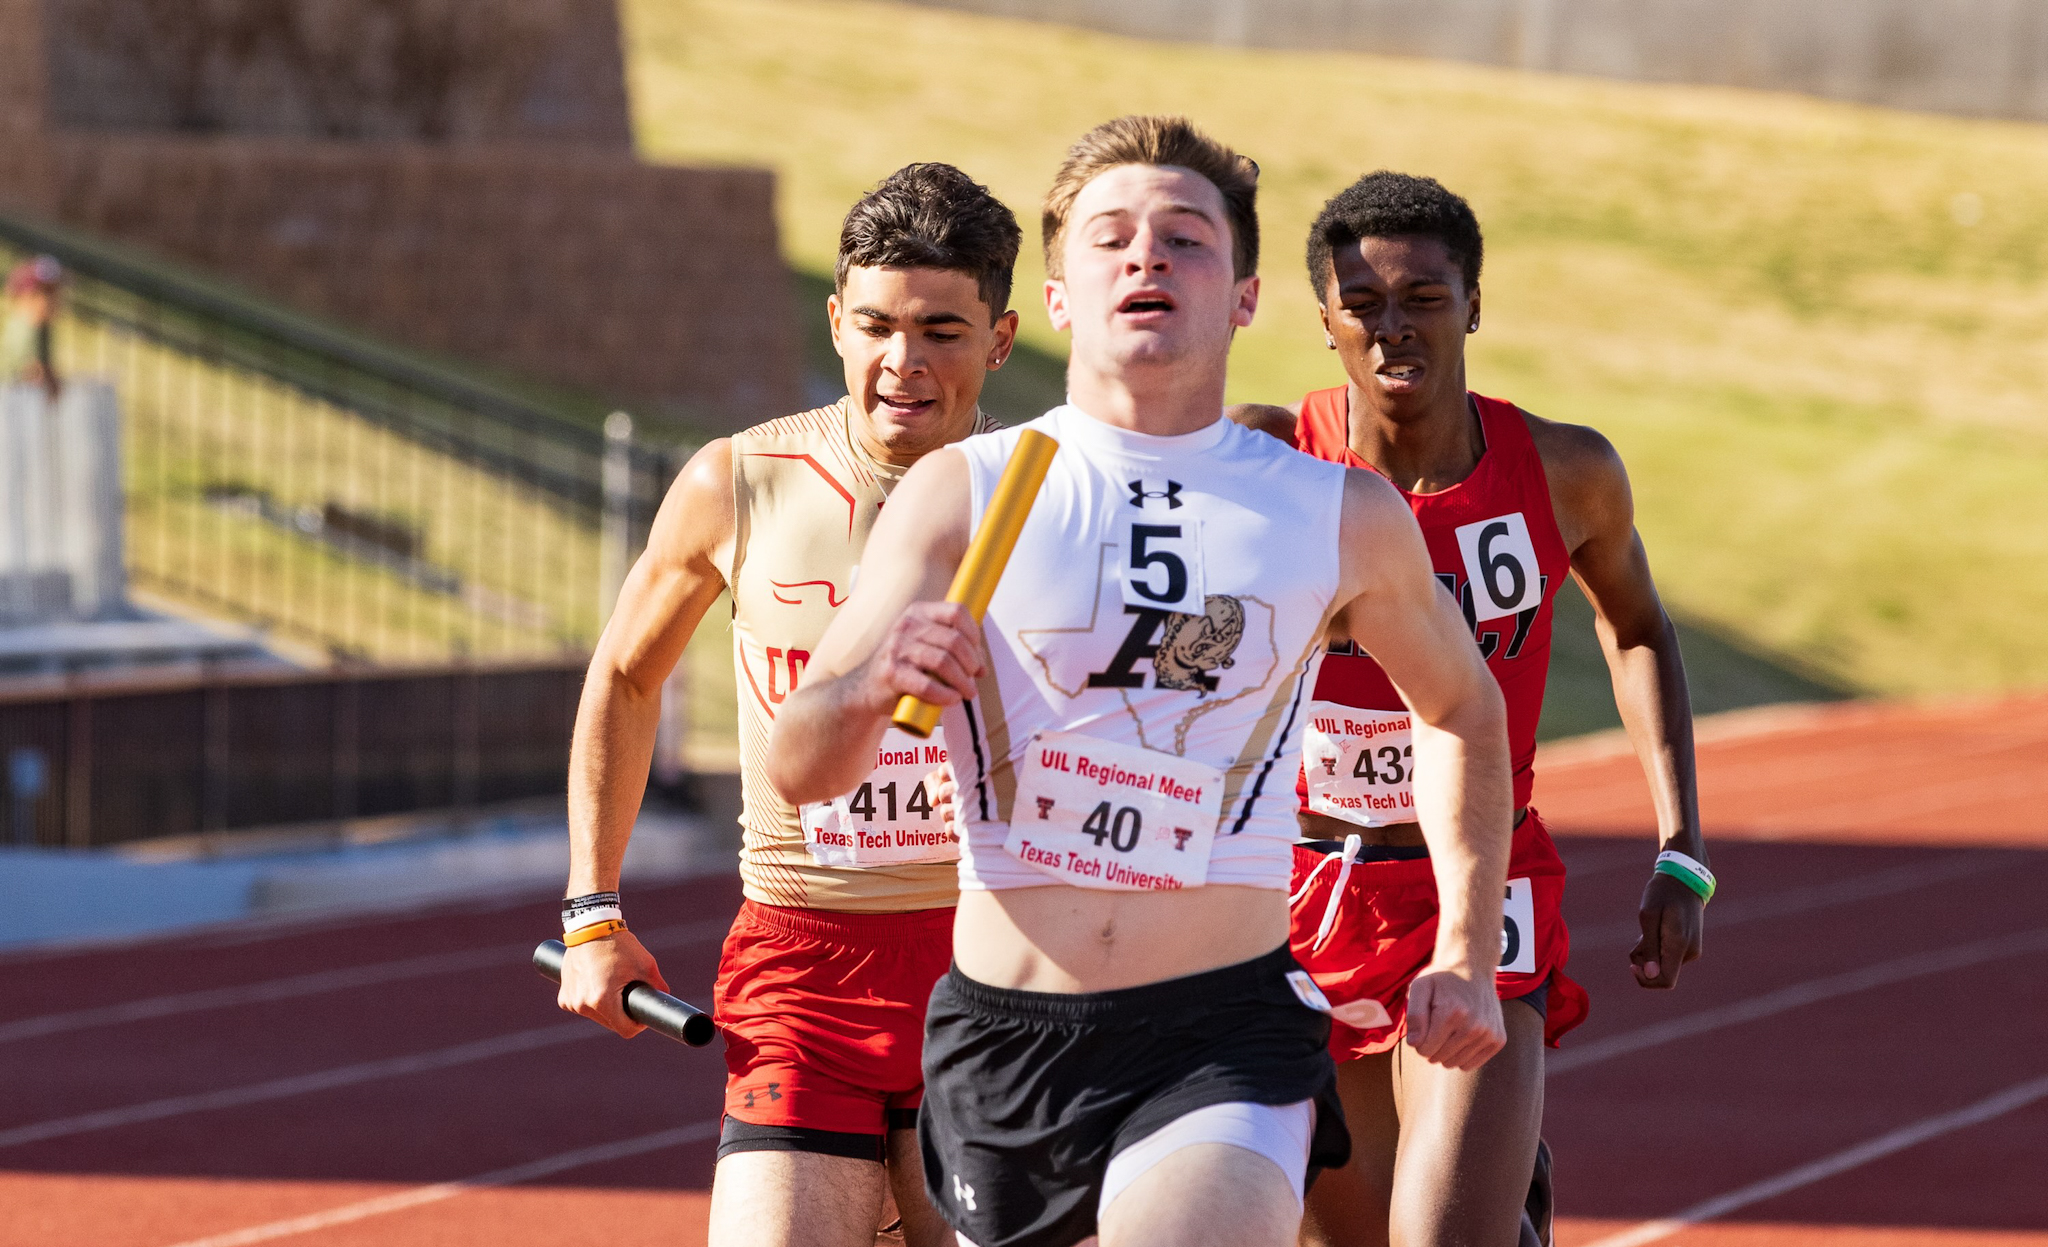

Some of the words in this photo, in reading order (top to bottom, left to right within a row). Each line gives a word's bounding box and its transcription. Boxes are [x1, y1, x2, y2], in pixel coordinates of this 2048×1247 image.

[1130, 523, 1188, 603] 5
[1478, 522, 1526, 610] 6
[1088, 604, 1220, 692] A
[1315, 718, 1341, 734] UIL
[1344, 717, 1411, 738] Regional
[875, 747, 918, 770] ional
[1041, 749, 1070, 772] UIL
[1077, 756, 1155, 791] Regional
[1158, 776, 1203, 804] Meet
[850, 781, 933, 821] 414
[1363, 794, 1396, 809] Tech
[815, 828, 853, 847] Texas
[858, 831, 891, 848] Tech
[896, 829, 951, 847] Univers
[1082, 801, 1142, 853] 40
[1020, 841, 1062, 867] Texas
[1067, 852, 1101, 877] Tech
[1106, 861, 1183, 889] University
